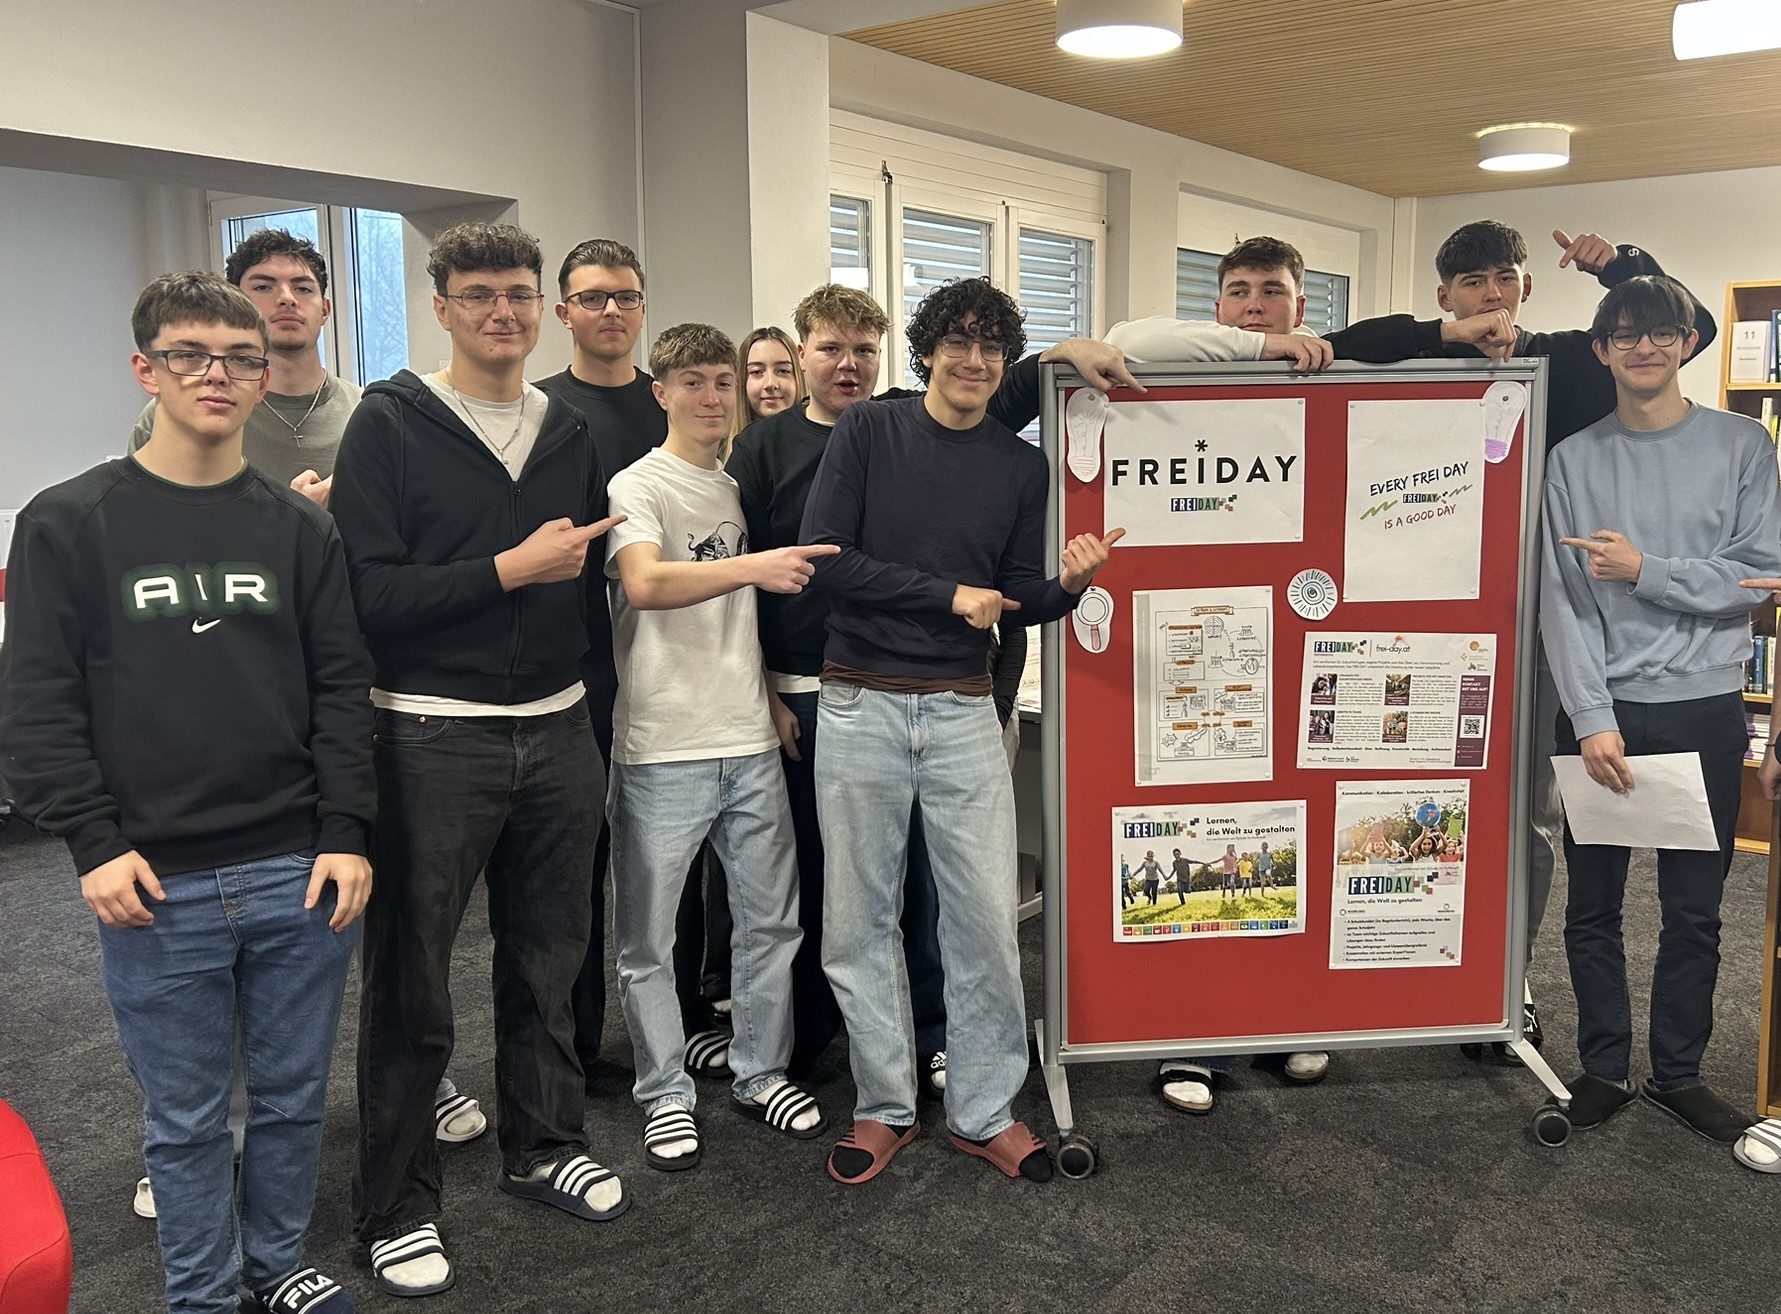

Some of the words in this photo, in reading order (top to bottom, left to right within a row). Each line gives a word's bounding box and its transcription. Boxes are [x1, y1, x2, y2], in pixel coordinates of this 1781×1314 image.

[1744, 330, 1755, 339] 11
[1370, 475, 1409, 496] EVERY
[1412, 468, 1440, 487] FREI
[1443, 461, 1469, 478] DAY
[1172, 498, 1218, 511] FREIDAY
[1403, 493, 1437, 503] FREIDAY
[1384, 519, 1393, 530] IS
[1396, 517, 1403, 527] A
[1406, 509, 1434, 524] GOOD
[1437, 504, 1456, 517] DAY
[133, 573, 268, 609] AIR
[1315, 642, 1352, 652] FREIDAY
[1376, 643, 1411, 654] frei-day.at
[1125, 822, 1179, 838] FREIDAY
[1206, 817, 1237, 825] Lernen,
[1206, 828, 1220, 836] die
[1221, 827, 1242, 835] Welt
[1255, 825, 1295, 836] gestalten
[1350, 876, 1412, 894] FREIDAY
[1397, 897, 1423, 905] gestalten
[283, 1274, 334, 1309] FILA
